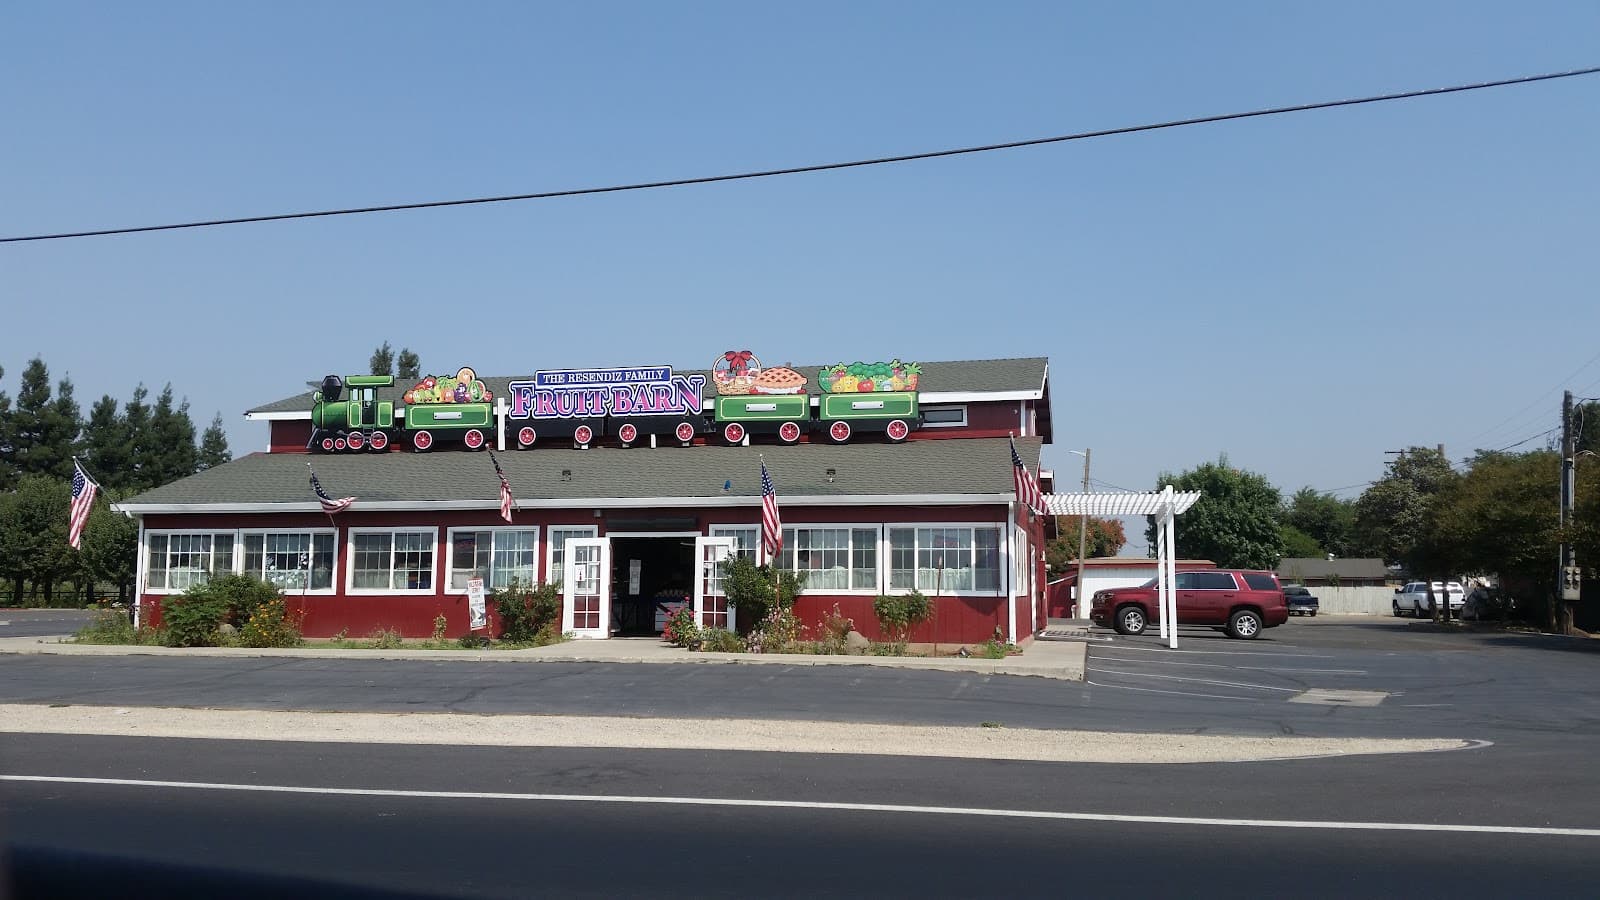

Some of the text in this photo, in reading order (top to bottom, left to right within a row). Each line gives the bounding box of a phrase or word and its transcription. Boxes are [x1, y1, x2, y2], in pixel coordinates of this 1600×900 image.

[543, 369, 665, 384] THE RESENDIZ FAMILY
[511, 377, 704, 417] FRUIT BARN
